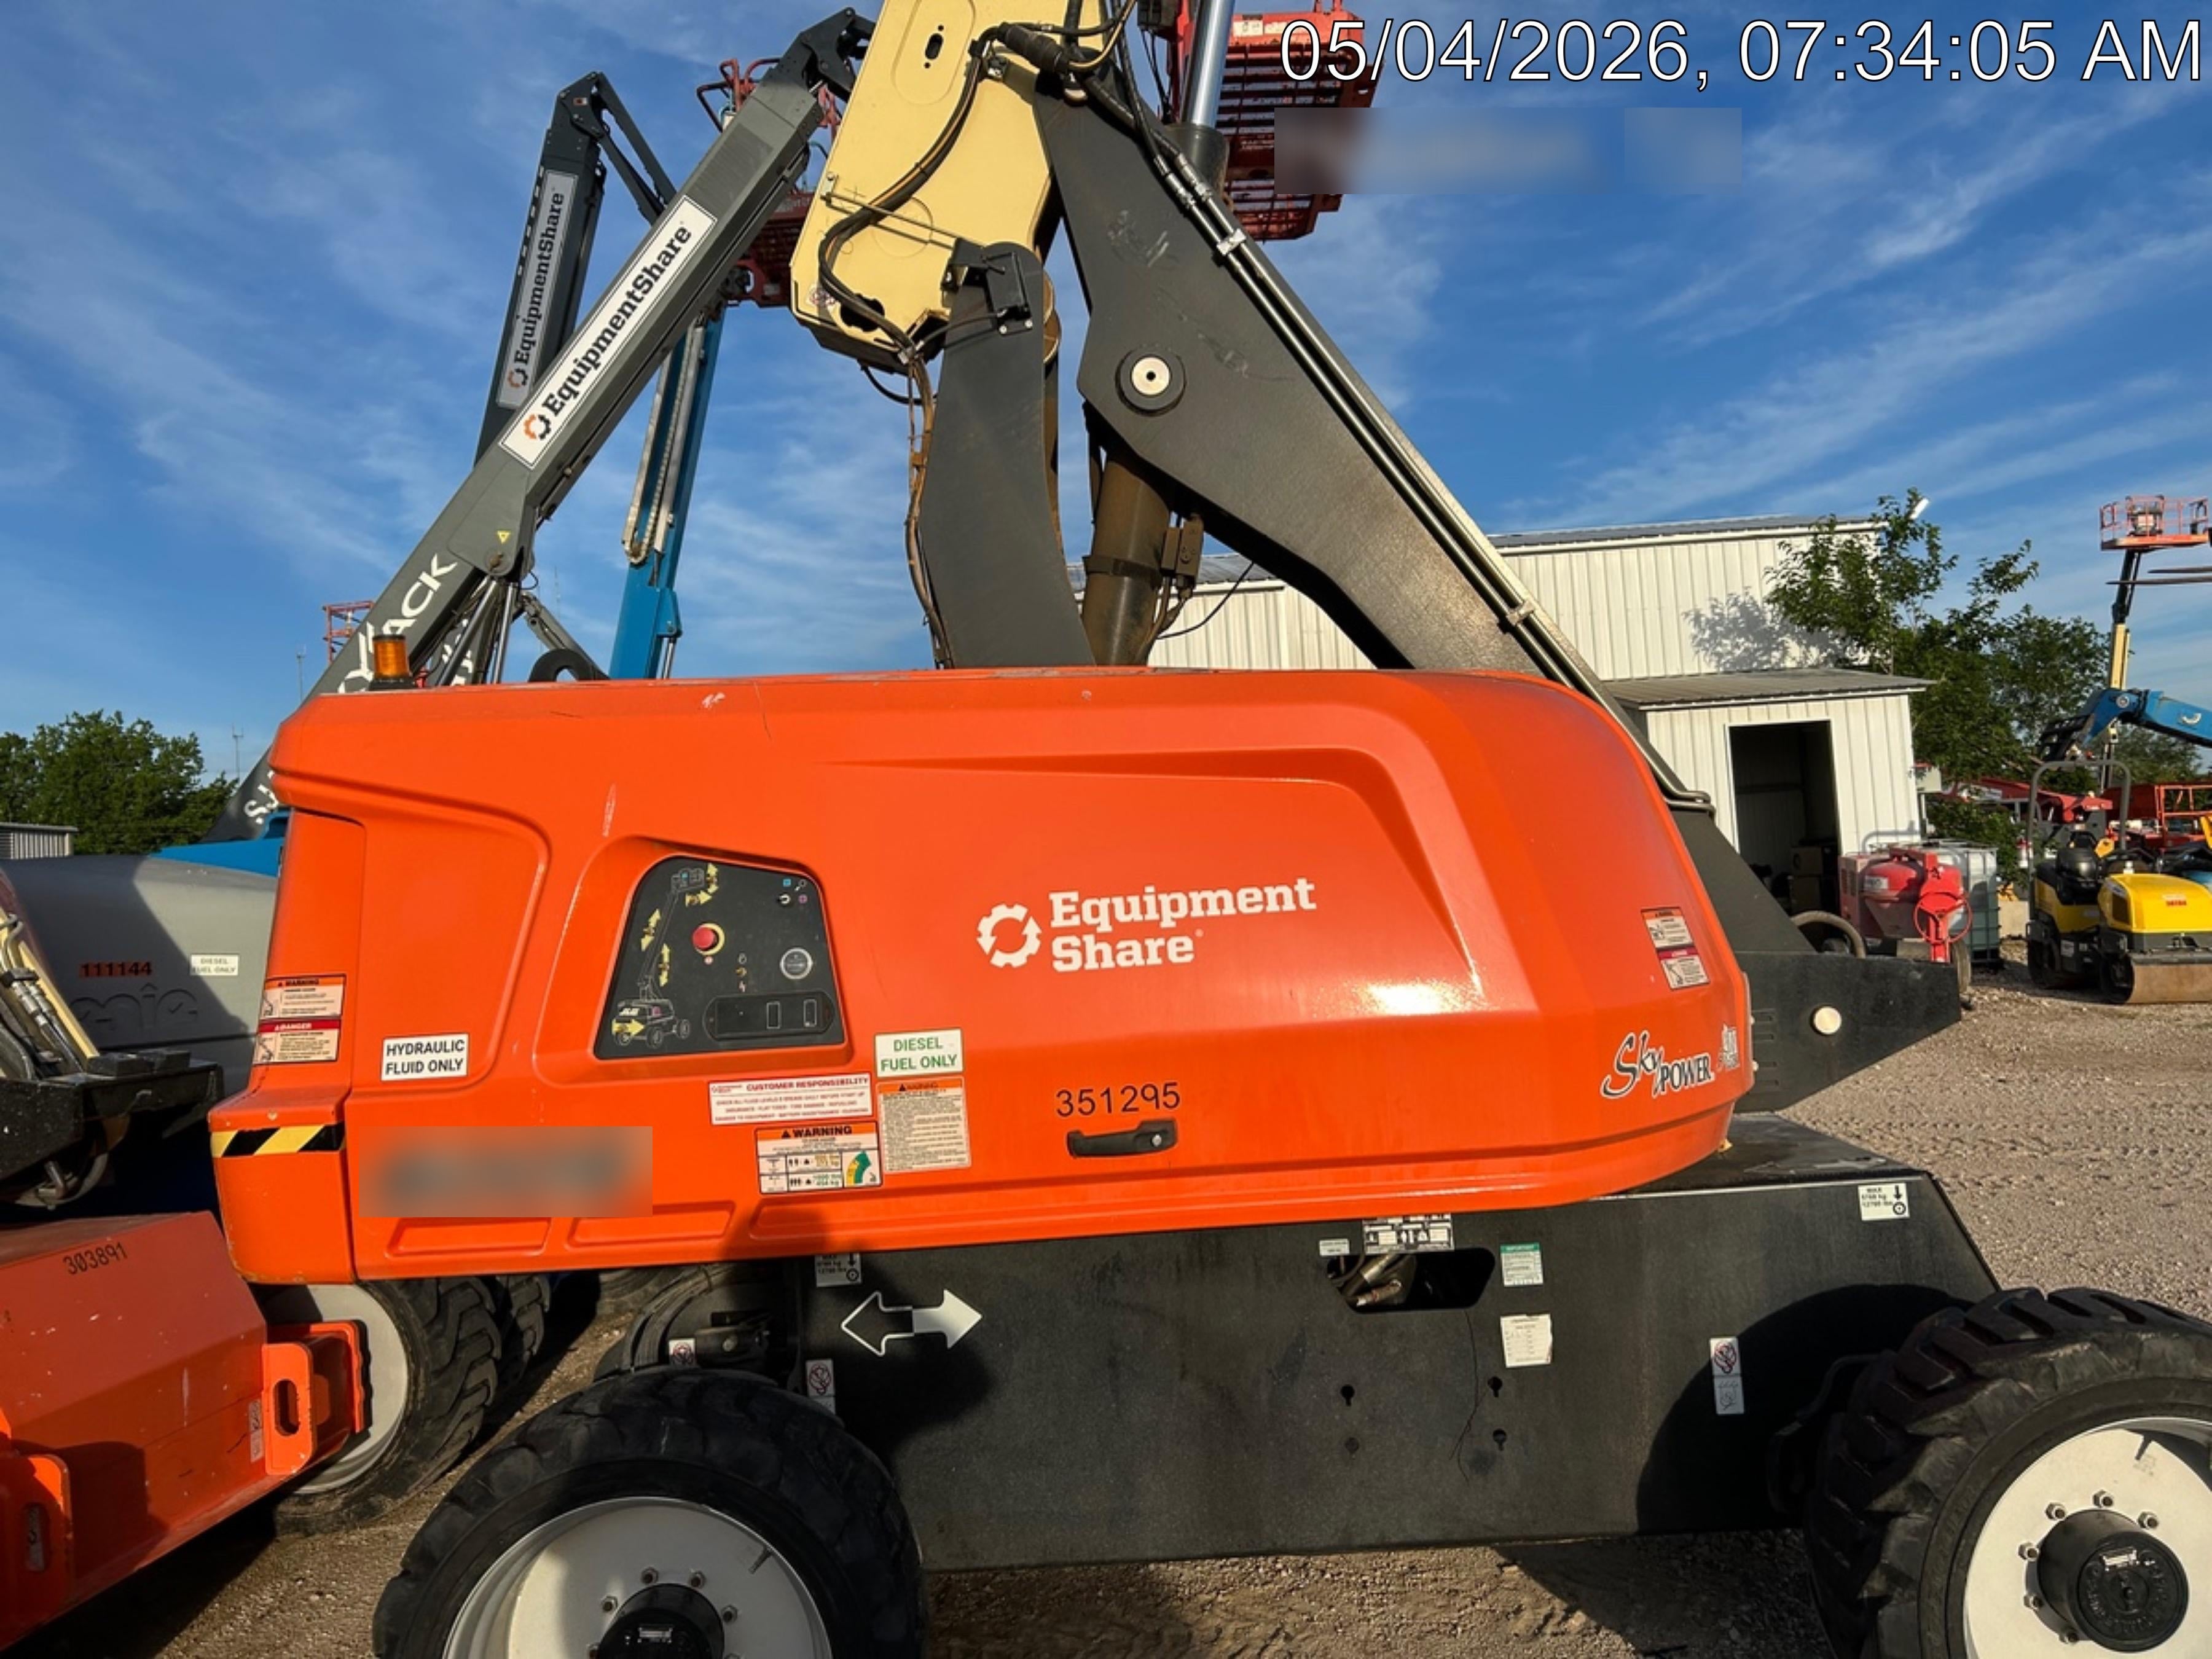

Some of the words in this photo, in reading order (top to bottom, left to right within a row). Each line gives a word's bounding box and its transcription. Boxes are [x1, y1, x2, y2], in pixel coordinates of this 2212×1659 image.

[514, 192, 564, 365] EquipmentShare
[542, 226, 691, 417] EquipmentShare
[337, 554, 458, 693] YACK
[1049, 878, 1317, 933] Equipment
[1052, 934, 1194, 972] Share
[81, 962, 152, 977] 111144
[386, 1039, 465, 1057] HYDRAULIC
[893, 1037, 944, 1052] DIESEL
[385, 1060, 425, 1075] FLUID
[428, 1058, 463, 1072] ONLY
[880, 1057, 917, 1072] FUEL
[920, 1054, 957, 1068] ONLY
[746, 1081, 794, 1092] CUSTOMER
[796, 1077, 868, 1088] RESPONSIBILITY
[1056, 1082, 1180, 1117] 351295
[793, 1126, 852, 1138] WARNING
[63, 1242, 128, 1275] 303891
